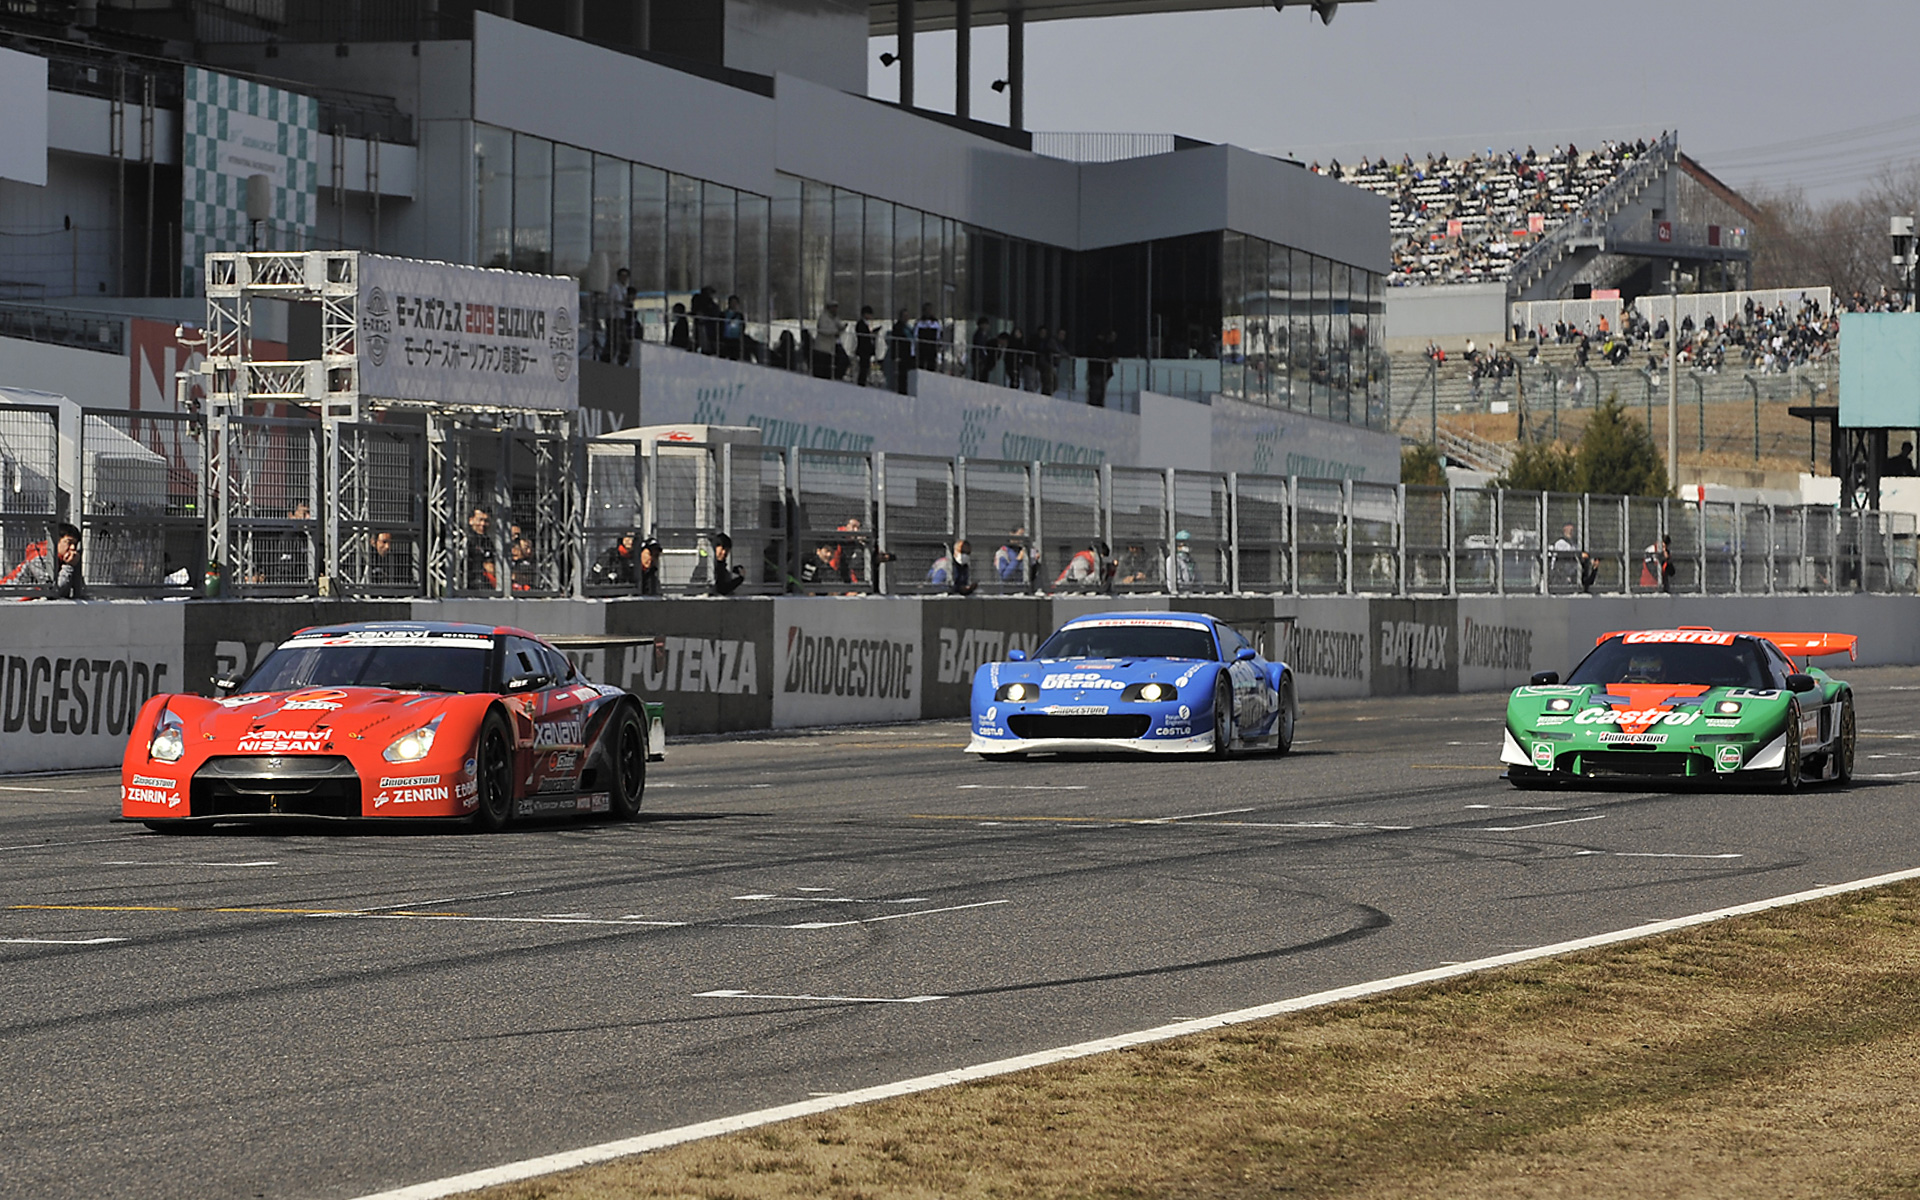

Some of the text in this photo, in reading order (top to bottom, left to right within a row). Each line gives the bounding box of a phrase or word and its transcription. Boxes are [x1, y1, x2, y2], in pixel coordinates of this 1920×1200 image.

[396, 295, 545, 341] モースポフェス 2019 SUZUKA
[1381, 620, 1448, 671] BATTLAX
[1463, 616, 1532, 671] BRIDGESTONE
[1627, 630, 1730, 645] Castrol
[621, 636, 757, 695] POTENZA
[784, 626, 914, 699] BRIDGESTONE
[1574, 706, 1701, 726] Castrol
[237, 741, 321, 751] NISSAN
[1600, 733, 1666, 743] BRIDGESTONE
[134, 775, 175, 788] BRIDGESTONE
[380, 776, 438, 787] BRIDGESTONE
[128, 787, 167, 804] ZENRIN
[393, 787, 449, 803] ZENRIN
